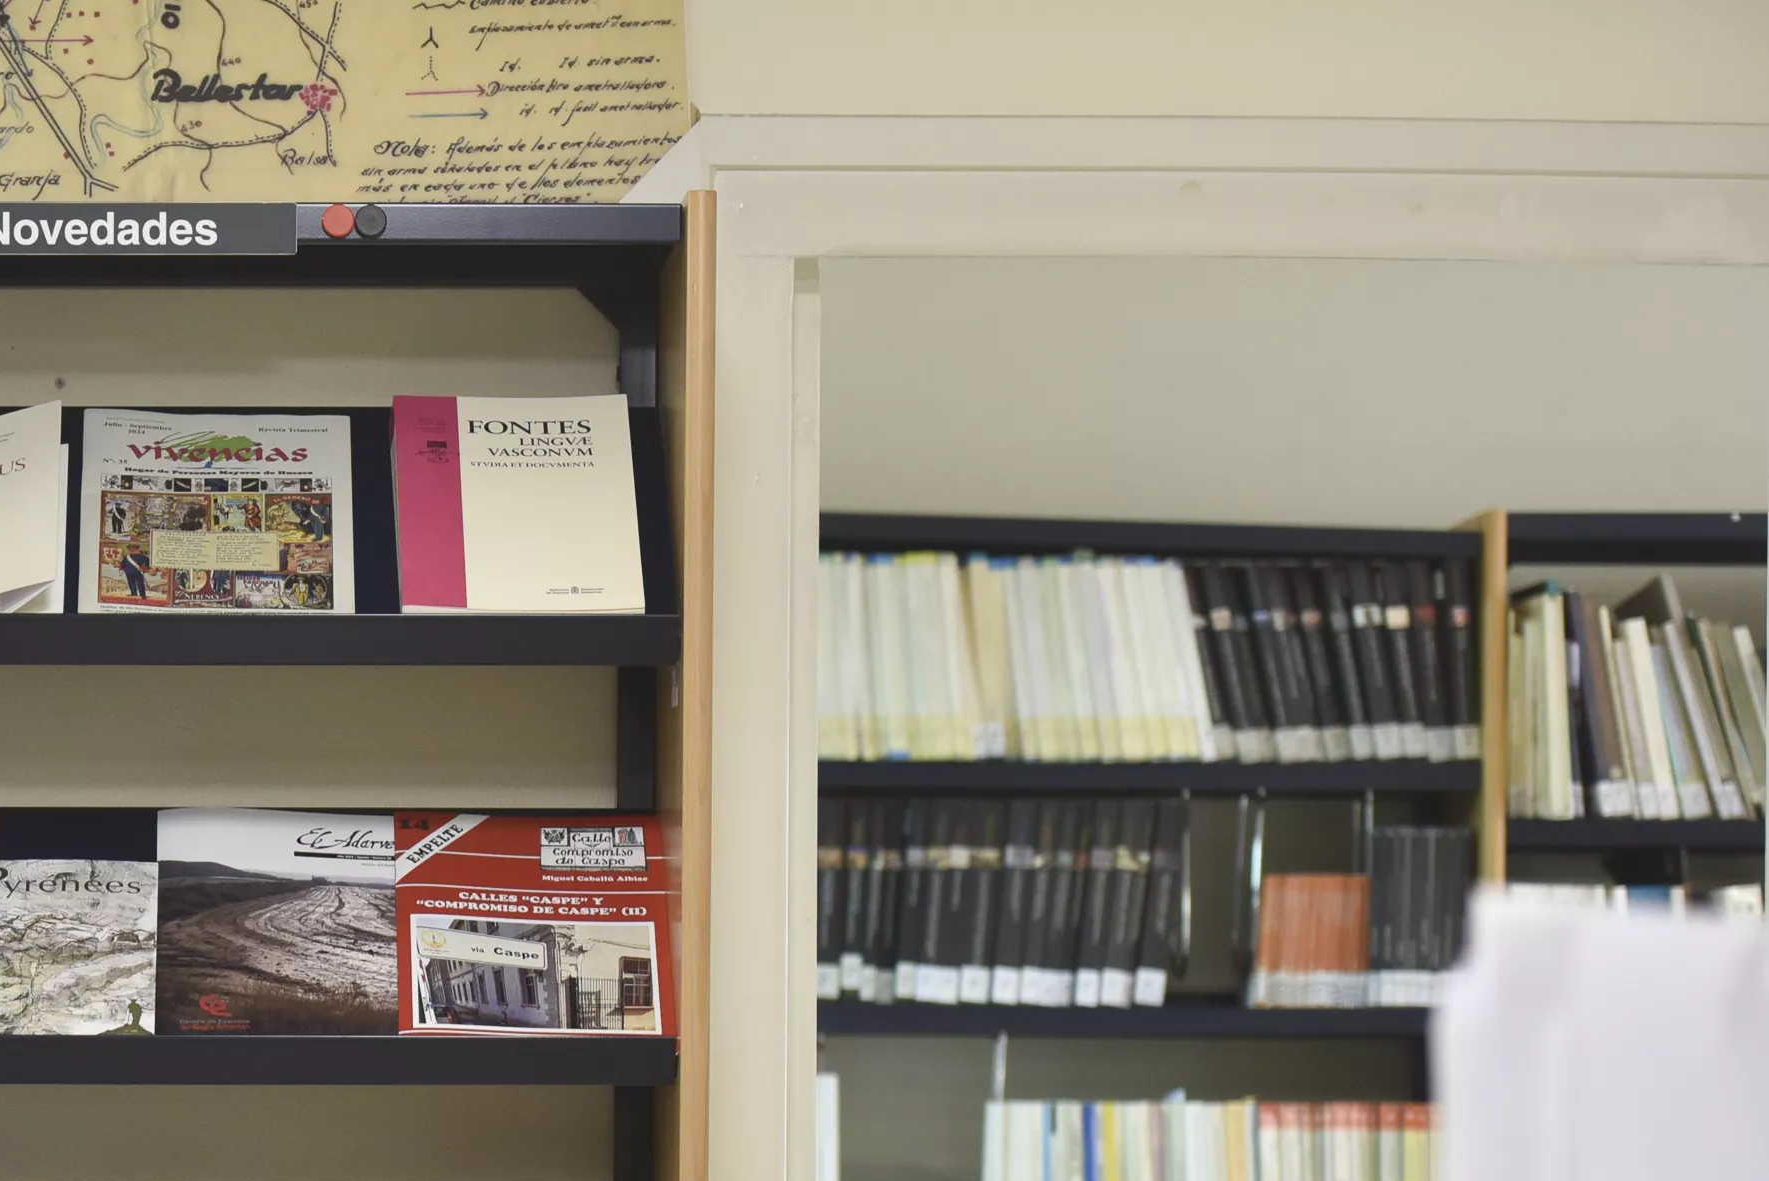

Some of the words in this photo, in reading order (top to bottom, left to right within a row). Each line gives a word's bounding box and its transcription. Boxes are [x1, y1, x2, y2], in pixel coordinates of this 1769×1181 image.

[467, 419, 592, 435] FONTES
[487, 447, 594, 457] VASCONVM
[333, 829, 395, 849] Adarve
[405, 823, 465, 865] EMPELTE
[571, 832, 611, 844] Calle
[552, 847, 634, 859] Compromiso
[555, 857, 574, 866] de
[581, 857, 626, 869] Caspe
[542, 875, 575, 883] Miguel
[458, 891, 518, 903] CALLES
[592, 897, 604, 905] Y
[533, 906, 555, 914] DE
[493, 946, 540, 960] Caspe
